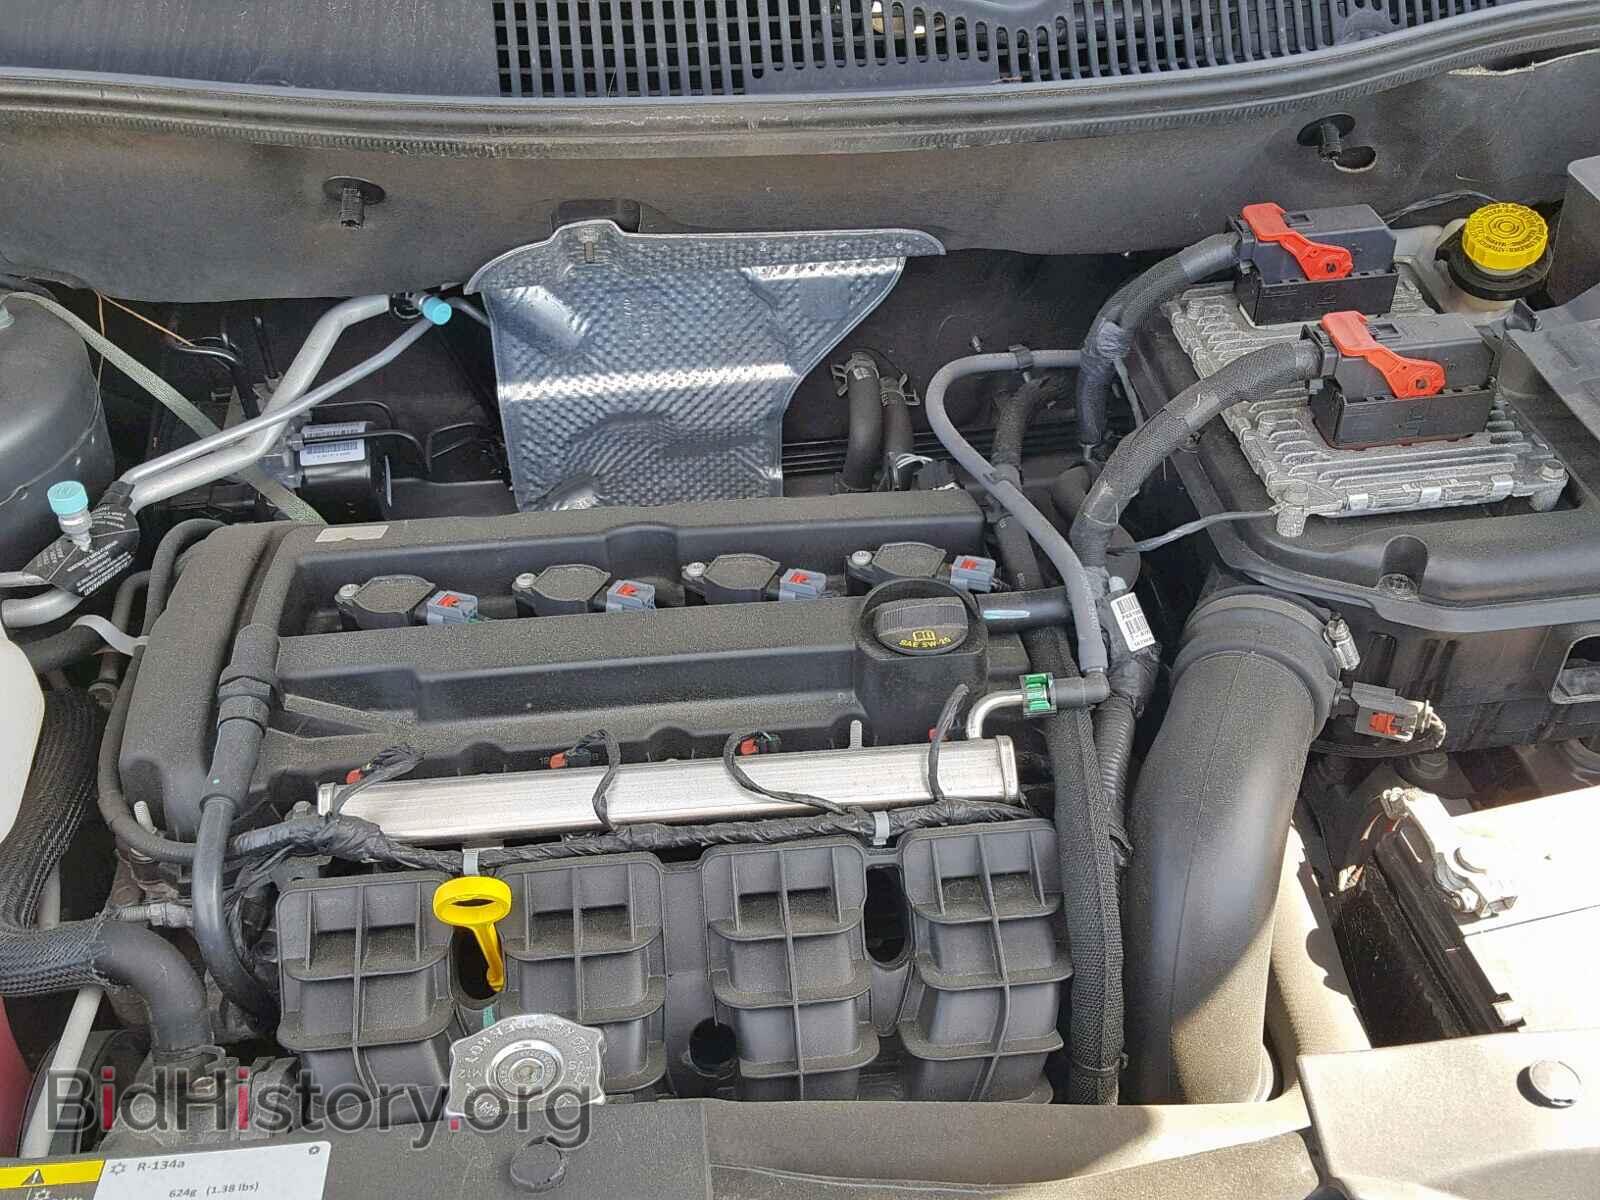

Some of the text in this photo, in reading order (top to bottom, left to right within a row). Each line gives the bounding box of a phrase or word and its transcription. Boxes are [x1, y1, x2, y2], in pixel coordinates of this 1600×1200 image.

[136, 1159, 185, 1172] R-134a
[169, 1181, 260, 1198] 624g (1.38 lbs)
